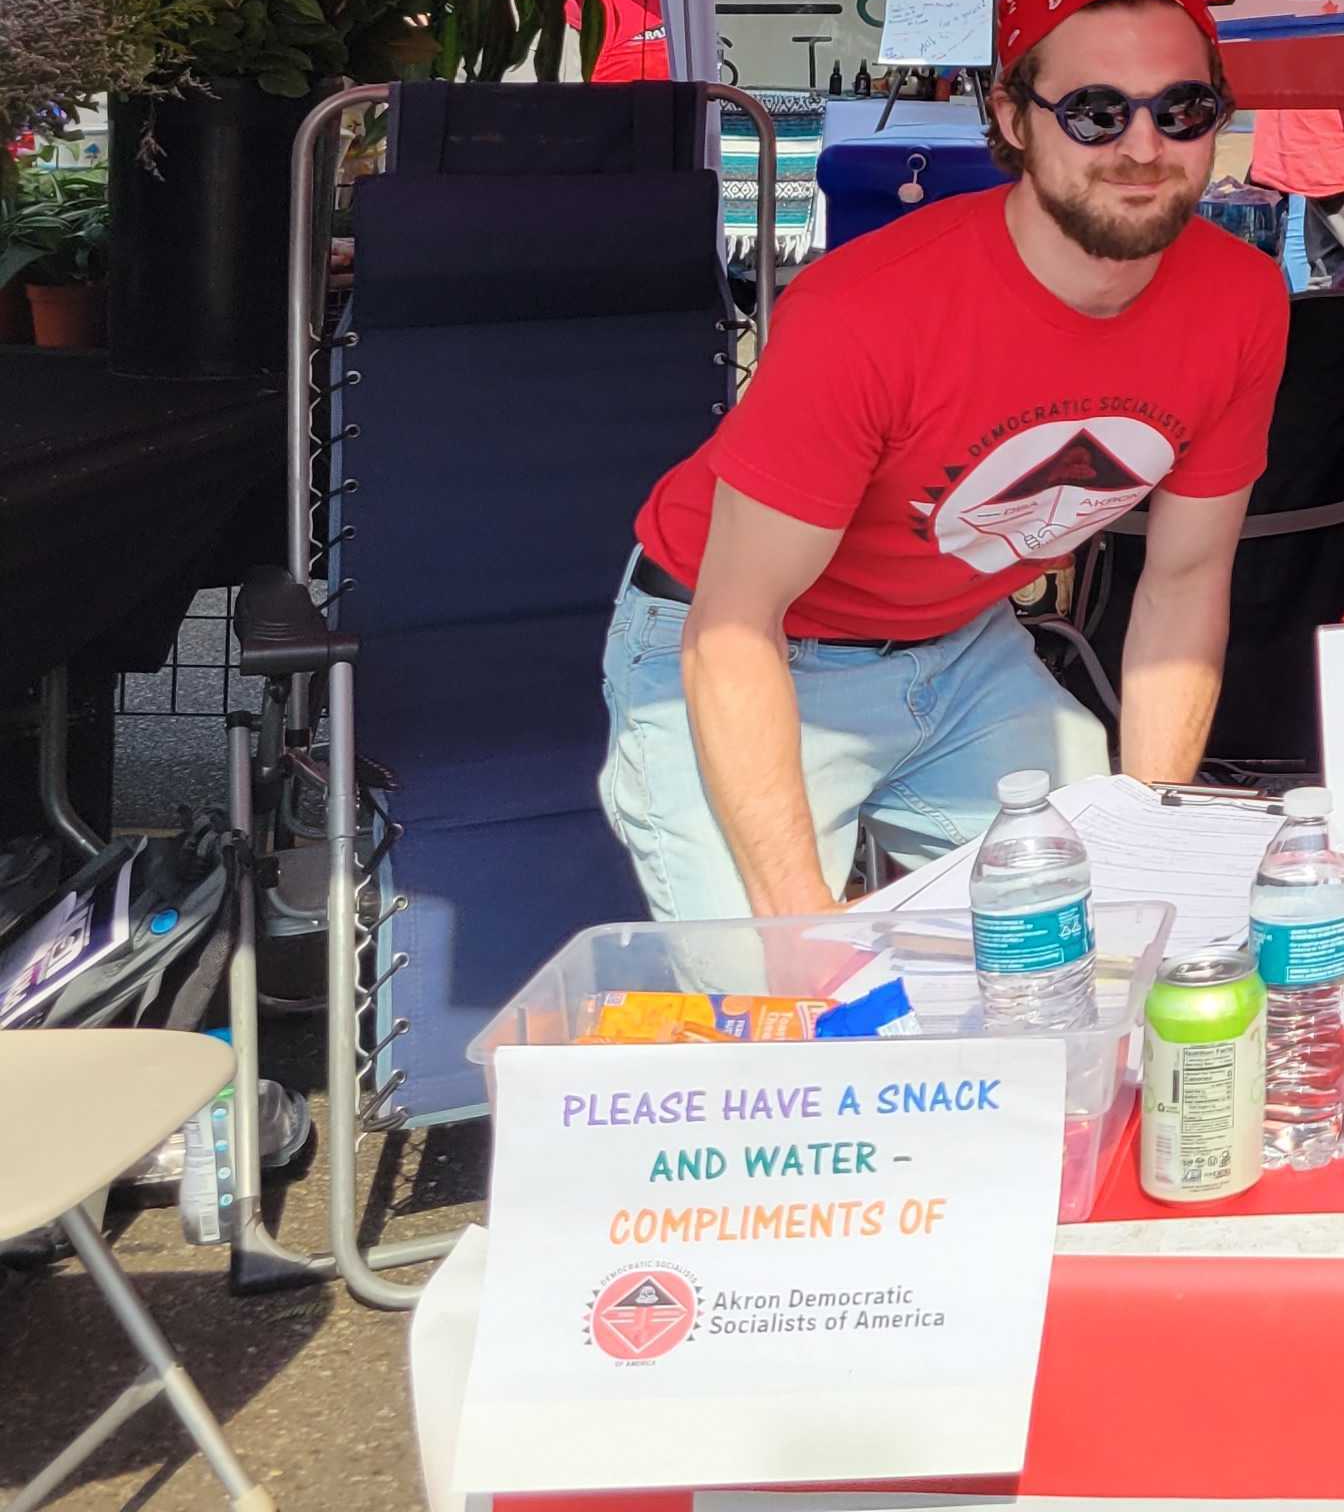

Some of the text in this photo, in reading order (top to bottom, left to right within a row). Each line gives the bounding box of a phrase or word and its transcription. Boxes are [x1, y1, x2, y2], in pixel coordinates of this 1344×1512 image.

[968, 396, 1187, 458] DEMOCRATIC SOCIALISTS
[562, 1078, 1000, 1128] PLEASE HAVE A SNACK
[650, 1140, 878, 1182] AND WATER
[608, 1196, 948, 1246] COMPLIMENTS OF
[709, 1308, 946, 1335] Socialists of America
[712, 1286, 914, 1311] Akron Democratic
